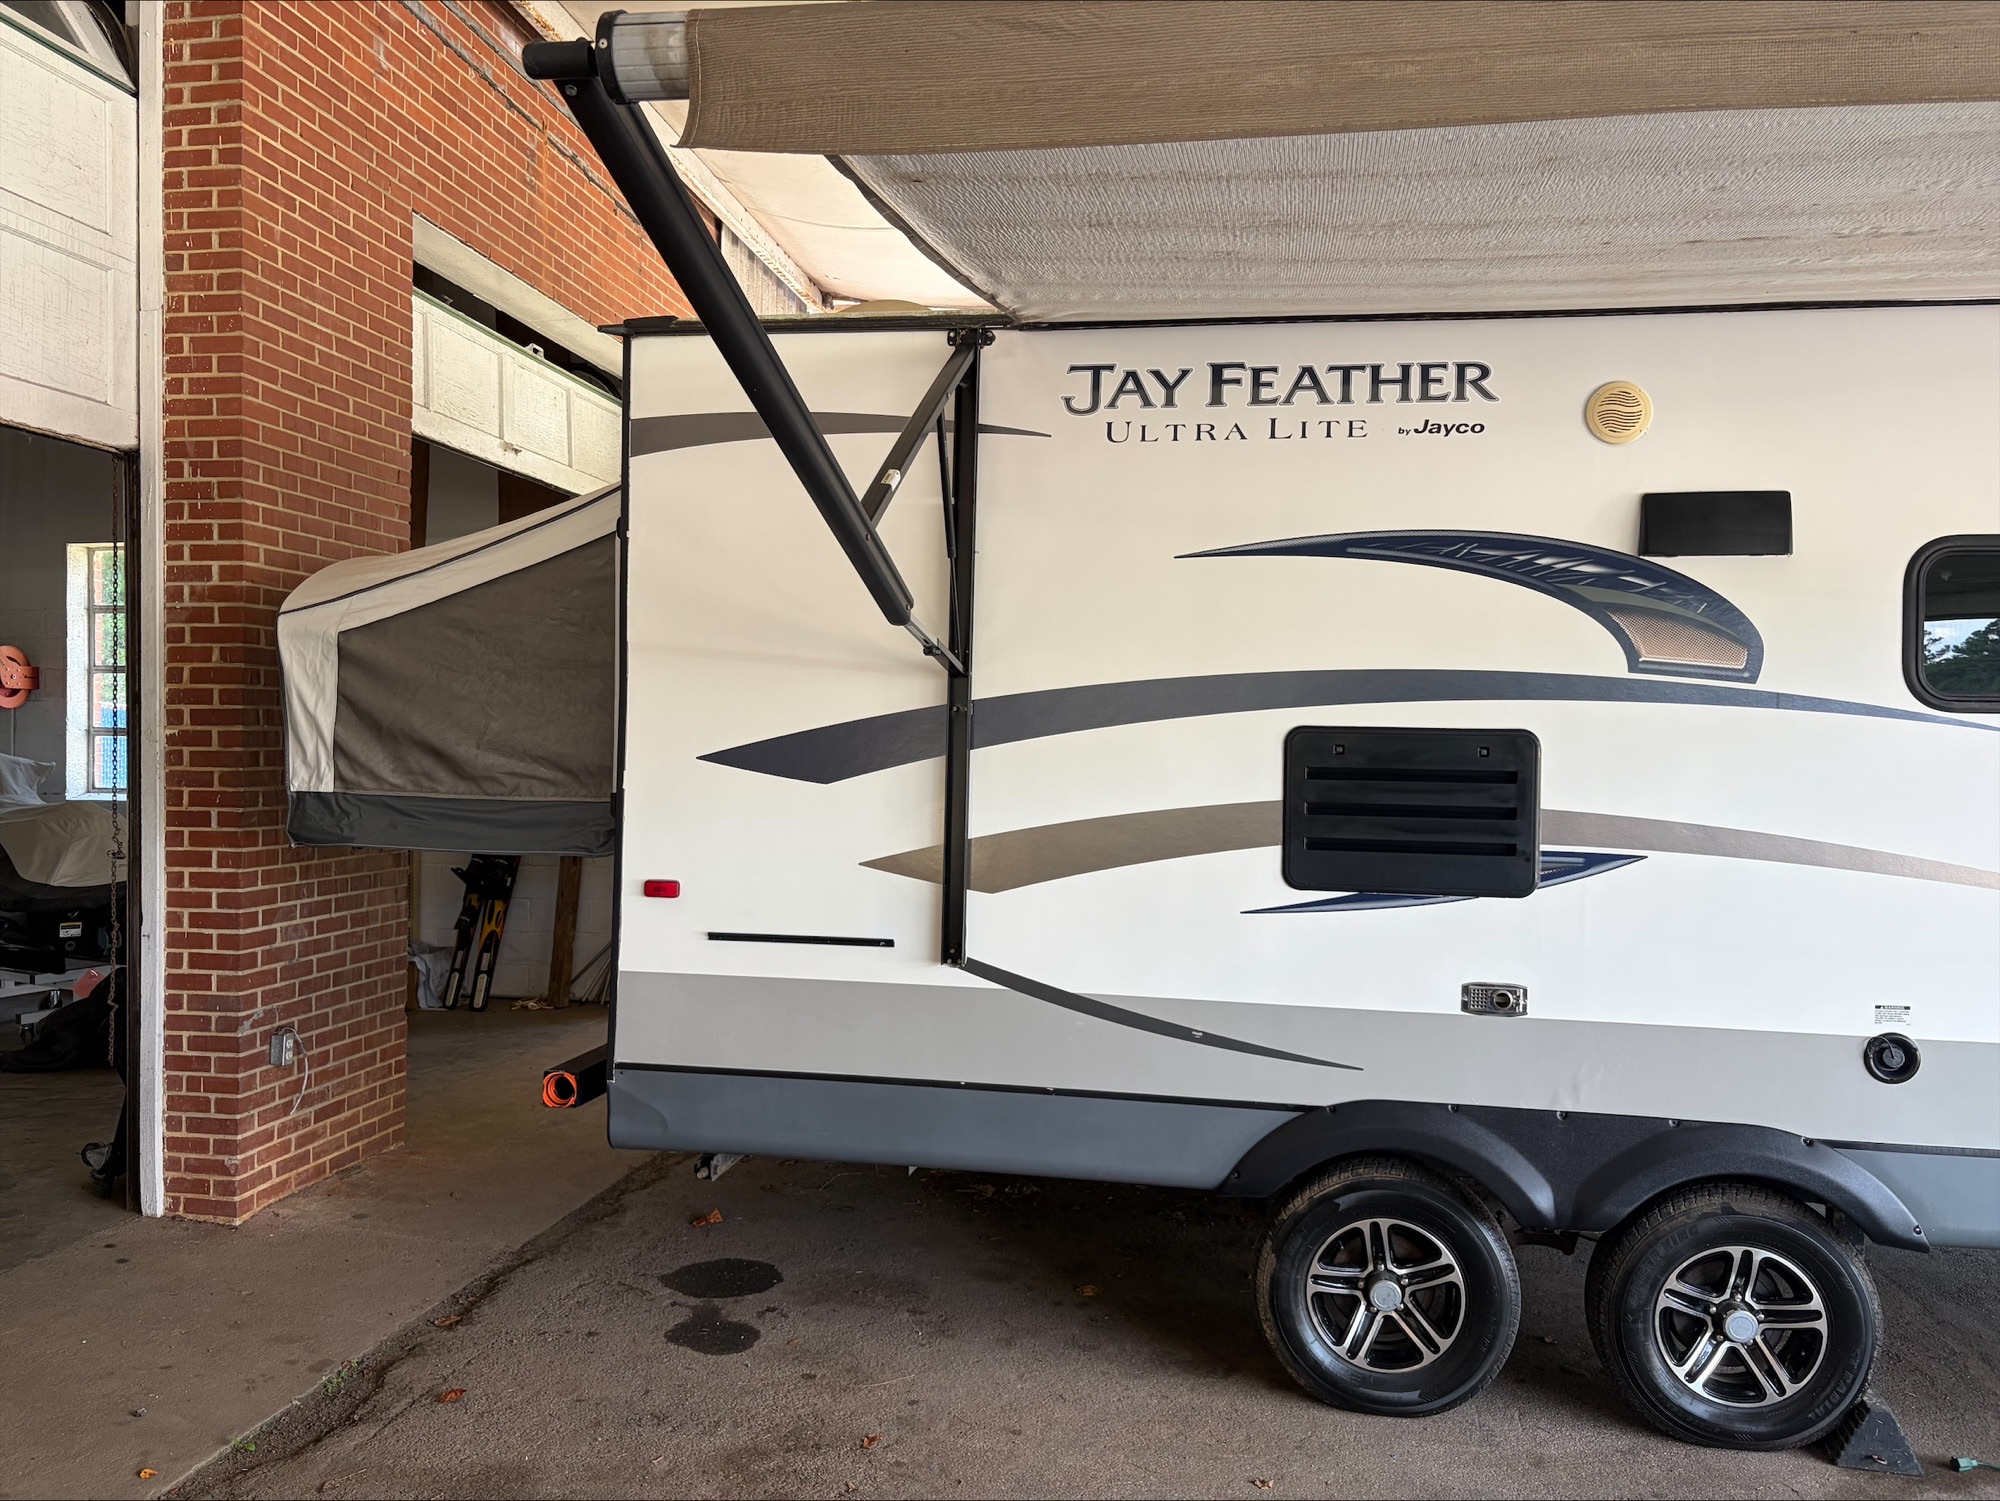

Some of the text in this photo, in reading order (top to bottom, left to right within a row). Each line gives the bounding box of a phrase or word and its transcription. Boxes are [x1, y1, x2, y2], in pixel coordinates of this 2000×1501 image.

[1060, 360, 1498, 416] JAY FEATHER
[1105, 417, 1485, 444] ULTRA LITE by Jayco
[1661, 1224, 1700, 1253] KING
[1806, 1370, 1855, 1422] RADIAL
